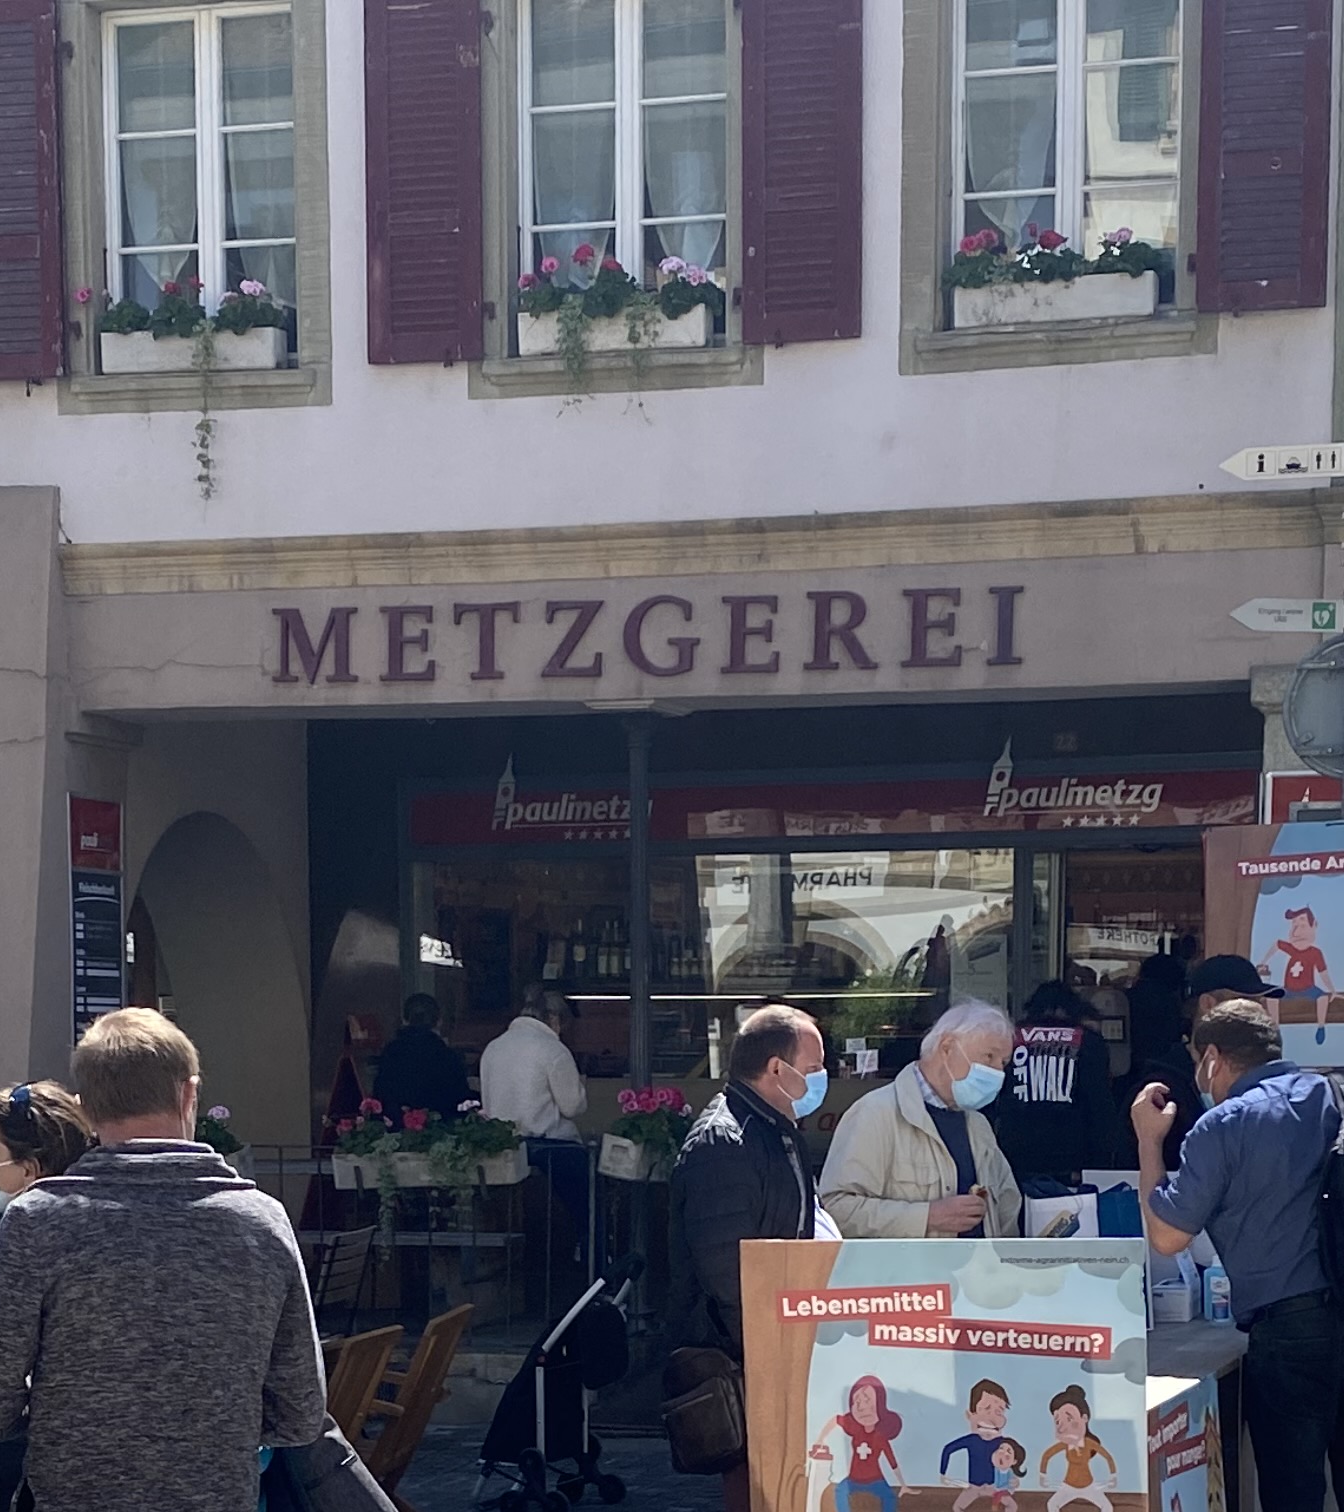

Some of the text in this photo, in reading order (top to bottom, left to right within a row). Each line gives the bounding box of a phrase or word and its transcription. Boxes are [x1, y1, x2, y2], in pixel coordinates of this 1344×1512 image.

[273, 586, 1024, 684] METZGEREI
[505, 793, 654, 830] paulimetz
[997, 777, 1164, 817] paulimetzg
[1238, 858, 1321, 876] Tausende
[1021, 1026, 1075, 1042] VANS
[1013, 1045, 1029, 1102] OFF
[782, 1290, 944, 1317] Lebensmittel
[874, 1323, 1105, 1353] massiv verteuern?
[1161, 1412, 1188, 1444] importer
